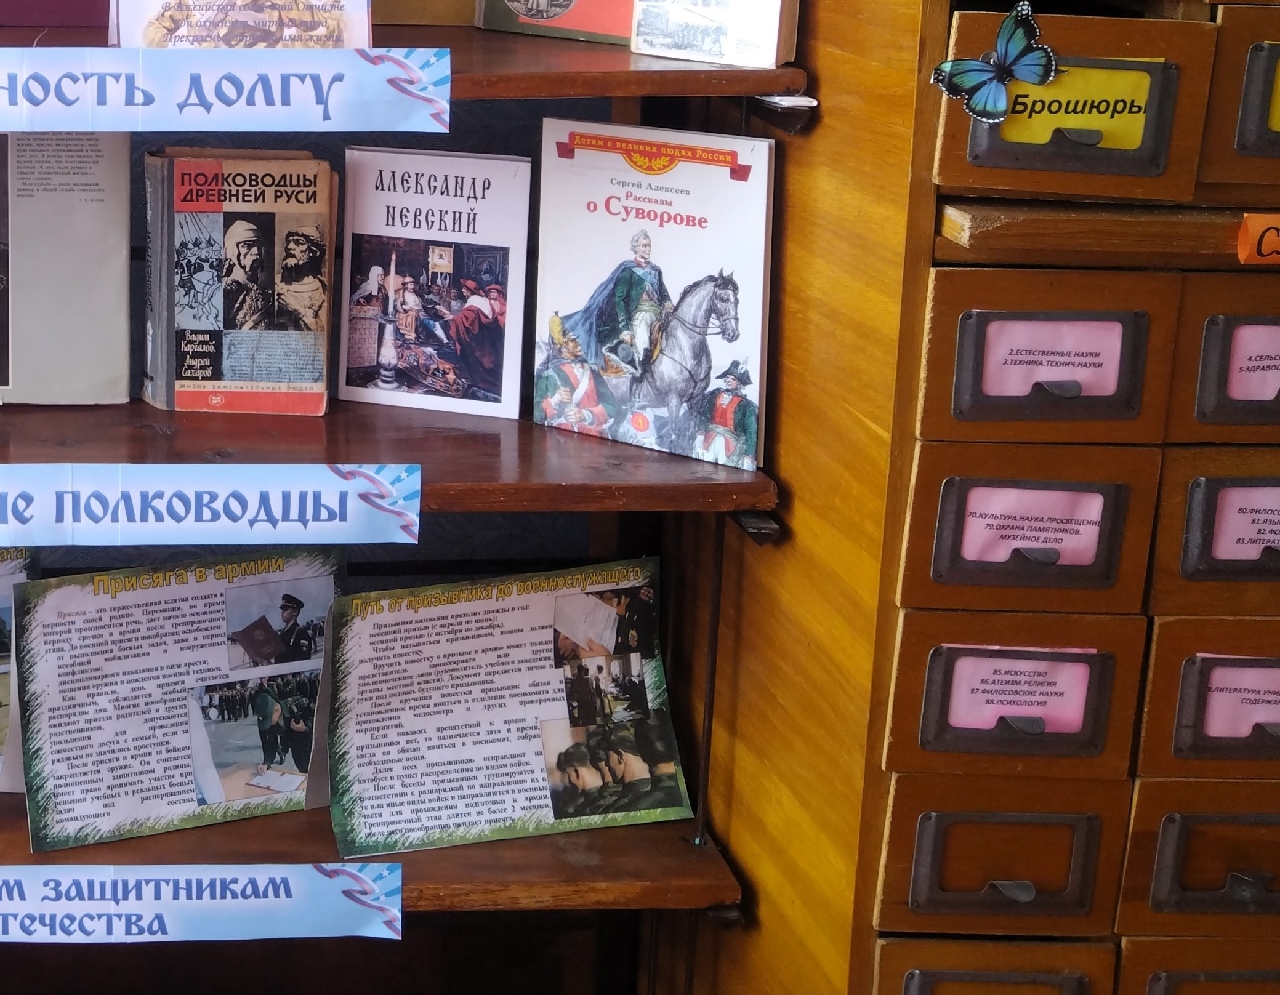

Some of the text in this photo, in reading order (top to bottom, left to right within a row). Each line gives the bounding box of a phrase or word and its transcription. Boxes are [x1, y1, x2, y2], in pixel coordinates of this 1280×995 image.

[177, 71, 345, 122] долгу
[573, 135, 604, 147] Детям
[616, 141, 657, 153] великих
[660, 146, 693, 158] людях
[696, 149, 732, 163] России
[180, 172, 317, 189] ПОЛКОВОДЦЫ
[375, 169, 492, 203] АЛЕКСАНДР
[610, 177, 691, 196] Сергей Алексеев
[181, 186, 317, 205] ДРЕВНЕЙ РУСИ
[625, 191, 673, 207] Рассказы
[385, 205, 478, 234] НЕВСКИЙ
[586, 195, 708, 229] о Суворове
[184, 355, 211, 368] Андрей
[54, 488, 349, 531] полководцы
[999, 534, 1063, 544] МУЗЕЙНОЕ ДЕЛО
[92, 556, 285, 598] Присяга в армии
[351, 565, 642, 621] Путь от призывника до военнослужащего
[1039, 690, 1065, 698] НАУКИ
[41, 874, 293, 907] защитникам
